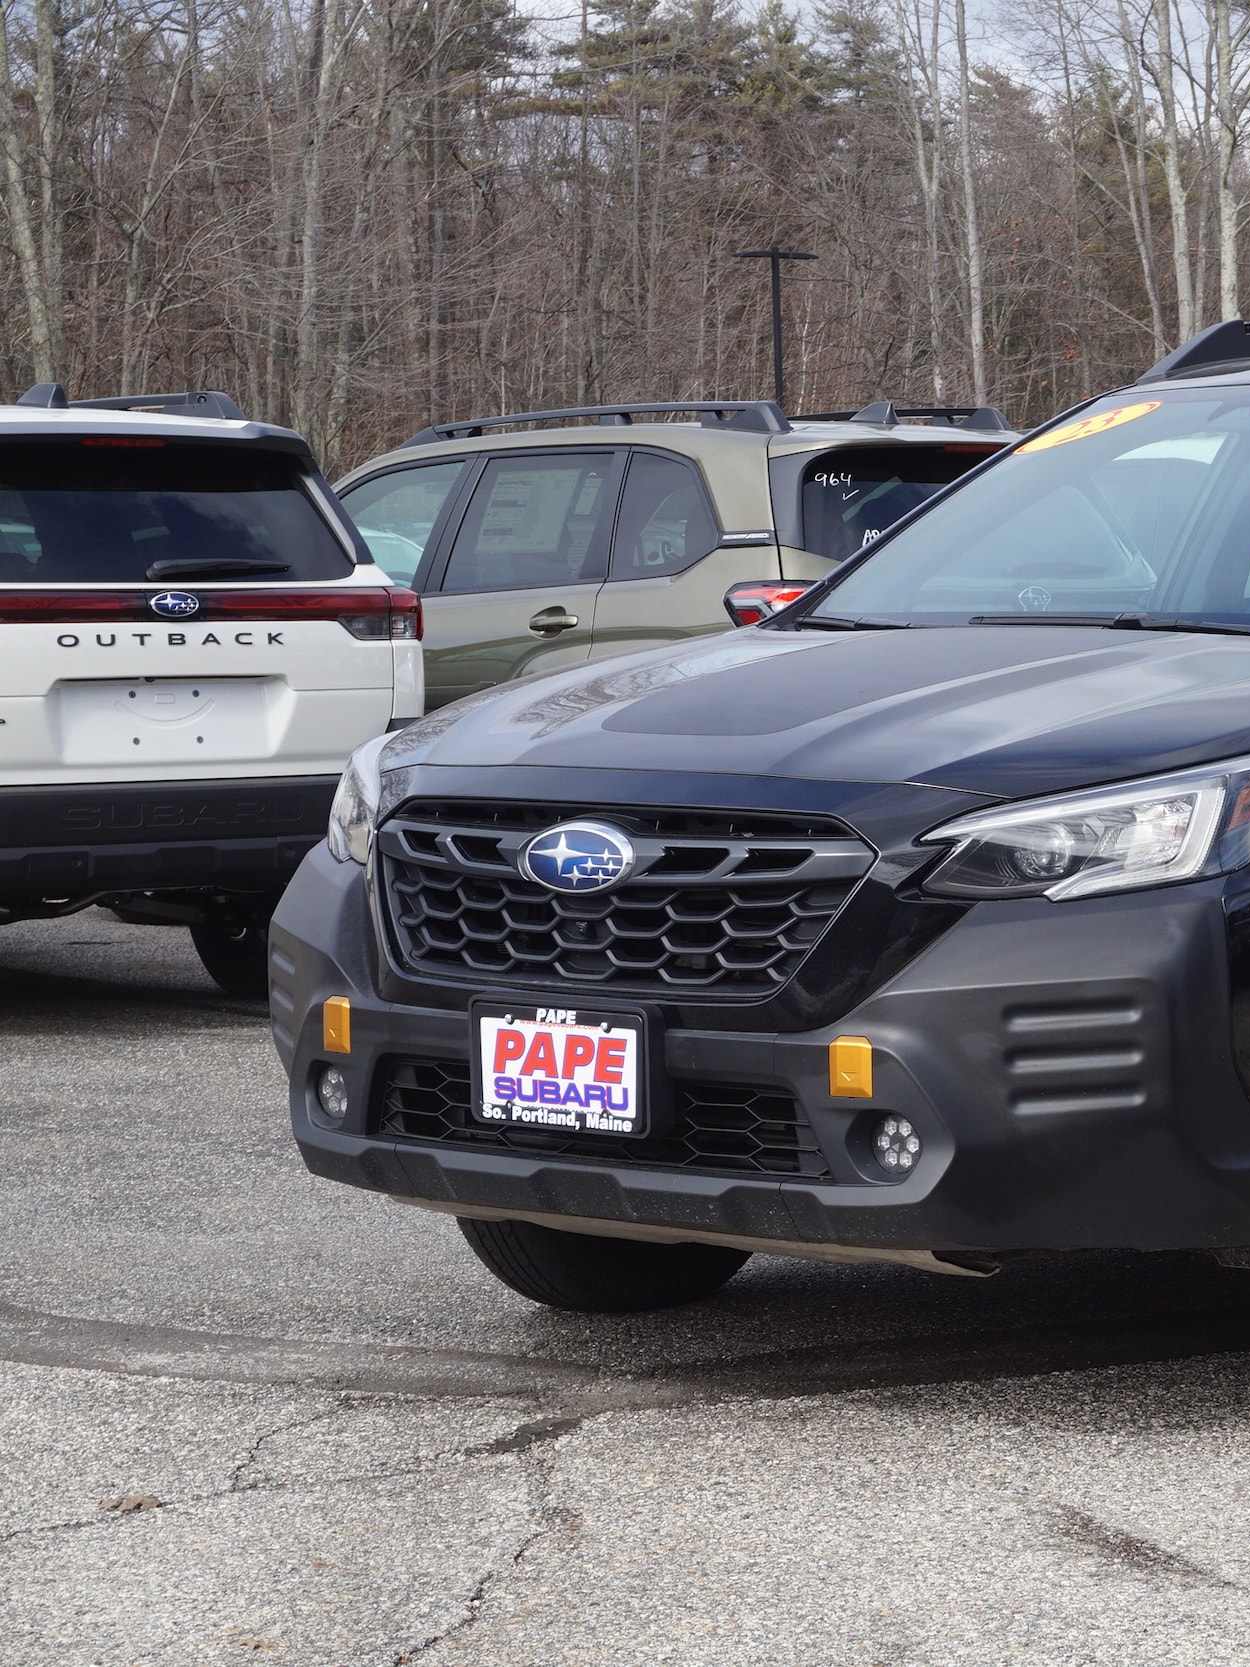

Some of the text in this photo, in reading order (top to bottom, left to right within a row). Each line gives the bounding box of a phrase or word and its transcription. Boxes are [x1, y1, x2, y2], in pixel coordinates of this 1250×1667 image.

[814, 472, 852, 488] 964
[56, 632, 286, 647] OUTBACK
[61, 799, 305, 831] SUBARU
[536, 1008, 577, 1024] PAPE
[493, 1029, 627, 1084] PAPE
[494, 1076, 628, 1111] SUBARU
[482, 1104, 507, 1119] So.
[511, 1105, 580, 1130] Portland,
[585, 1112, 633, 1133] Maine
